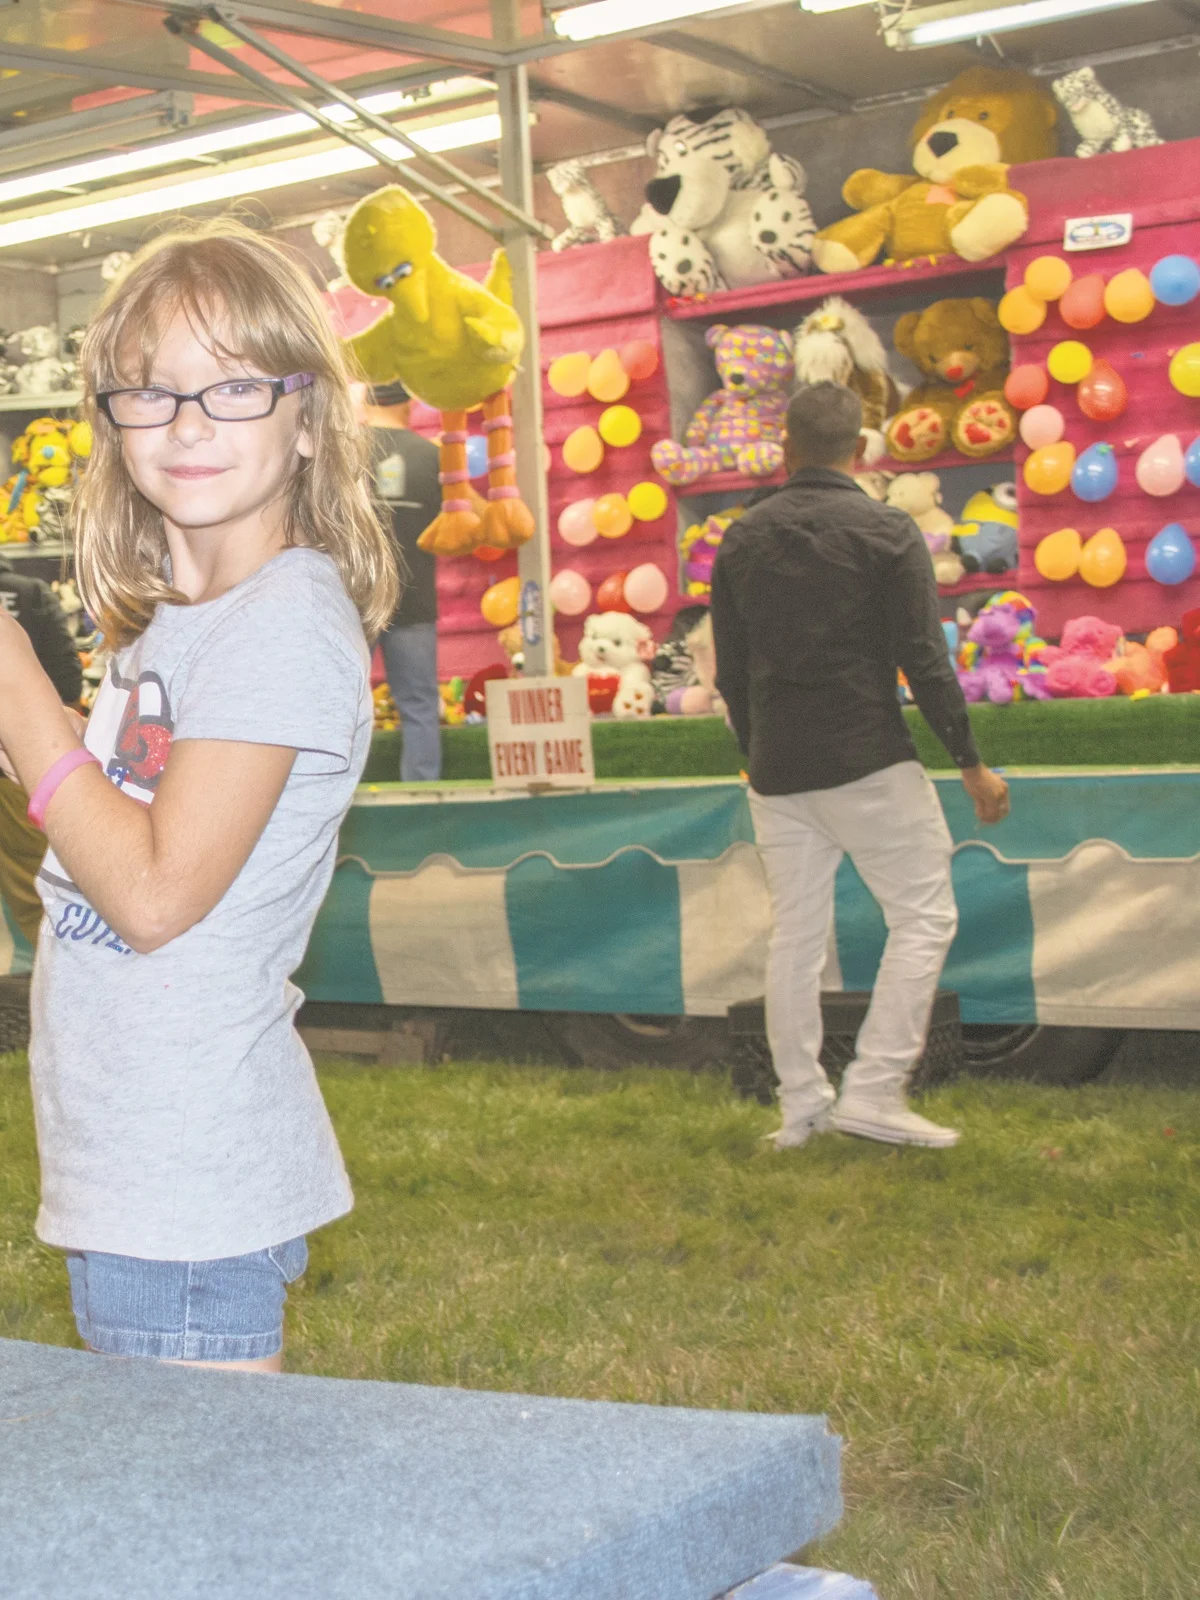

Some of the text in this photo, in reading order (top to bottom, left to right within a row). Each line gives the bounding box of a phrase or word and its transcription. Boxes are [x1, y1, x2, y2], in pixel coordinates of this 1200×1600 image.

[507, 687, 564, 725] WINNER
[495, 739, 586, 776] EVERY GAME
